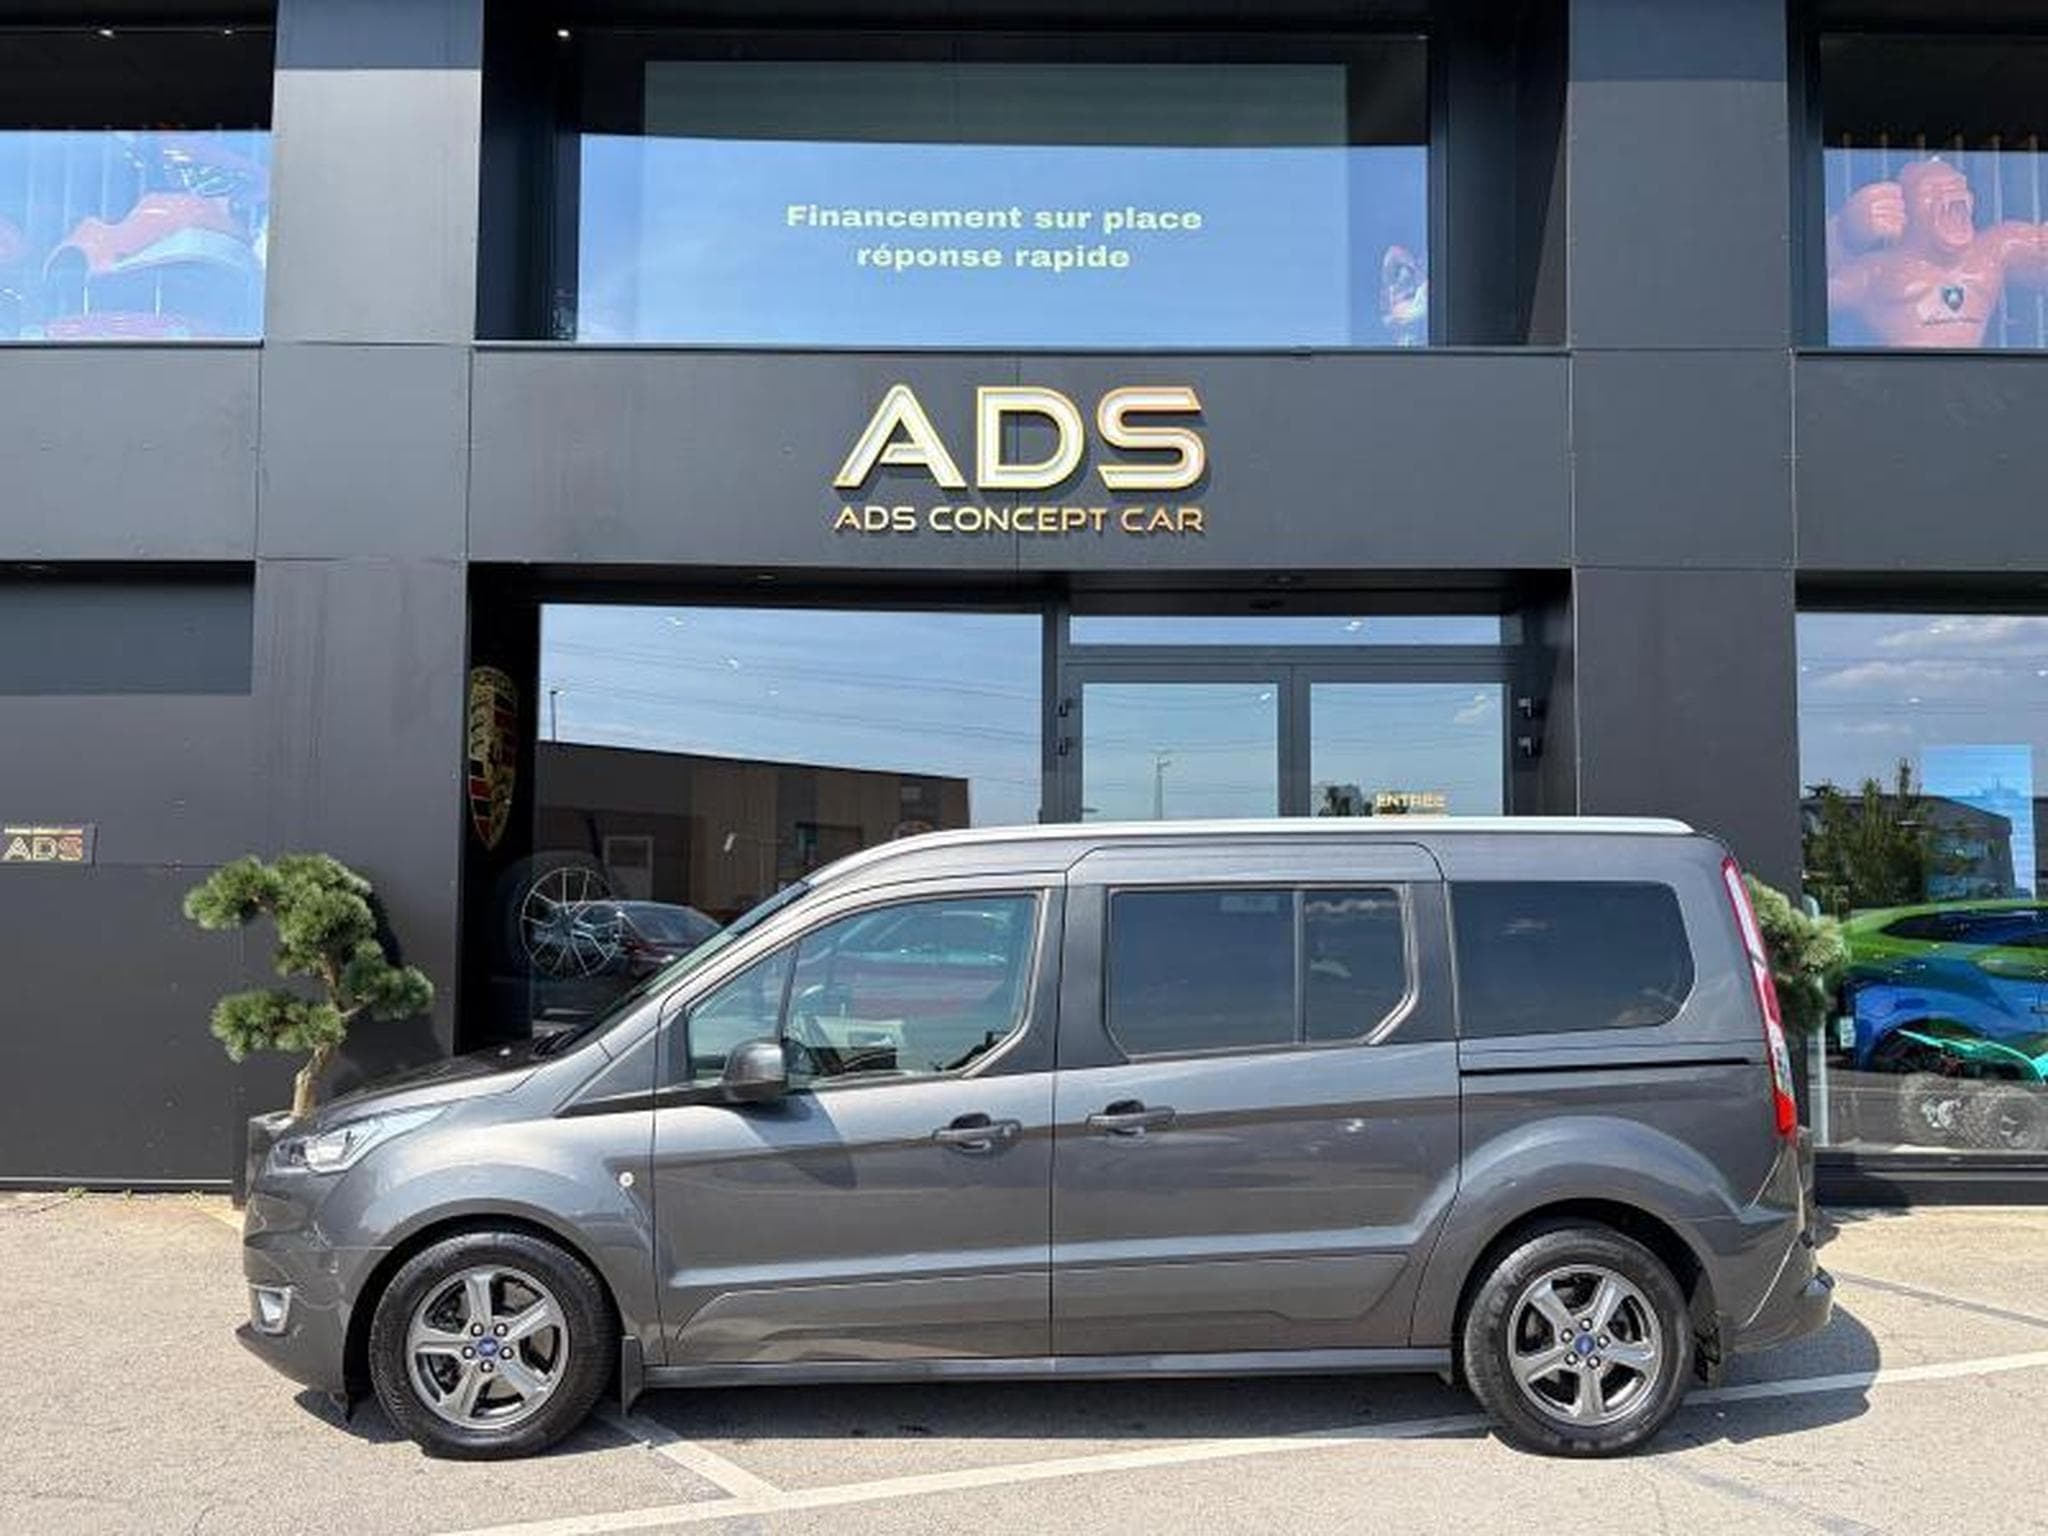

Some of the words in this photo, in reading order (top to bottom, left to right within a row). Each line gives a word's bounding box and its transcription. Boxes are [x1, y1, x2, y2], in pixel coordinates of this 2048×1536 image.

[786, 205, 1022, 230] Financement
[1034, 210, 1092, 229] sur
[1103, 207, 1202, 234] place
[856, 244, 1002, 272] réponse
[1015, 246, 1130, 272] rapide
[834, 384, 1206, 490] ADS
[834, 507, 917, 532] ADS
[930, 507, 1106, 532] CONCEPT
[1121, 508, 1205, 534] CAR
[3, 836, 83, 861] ADS
